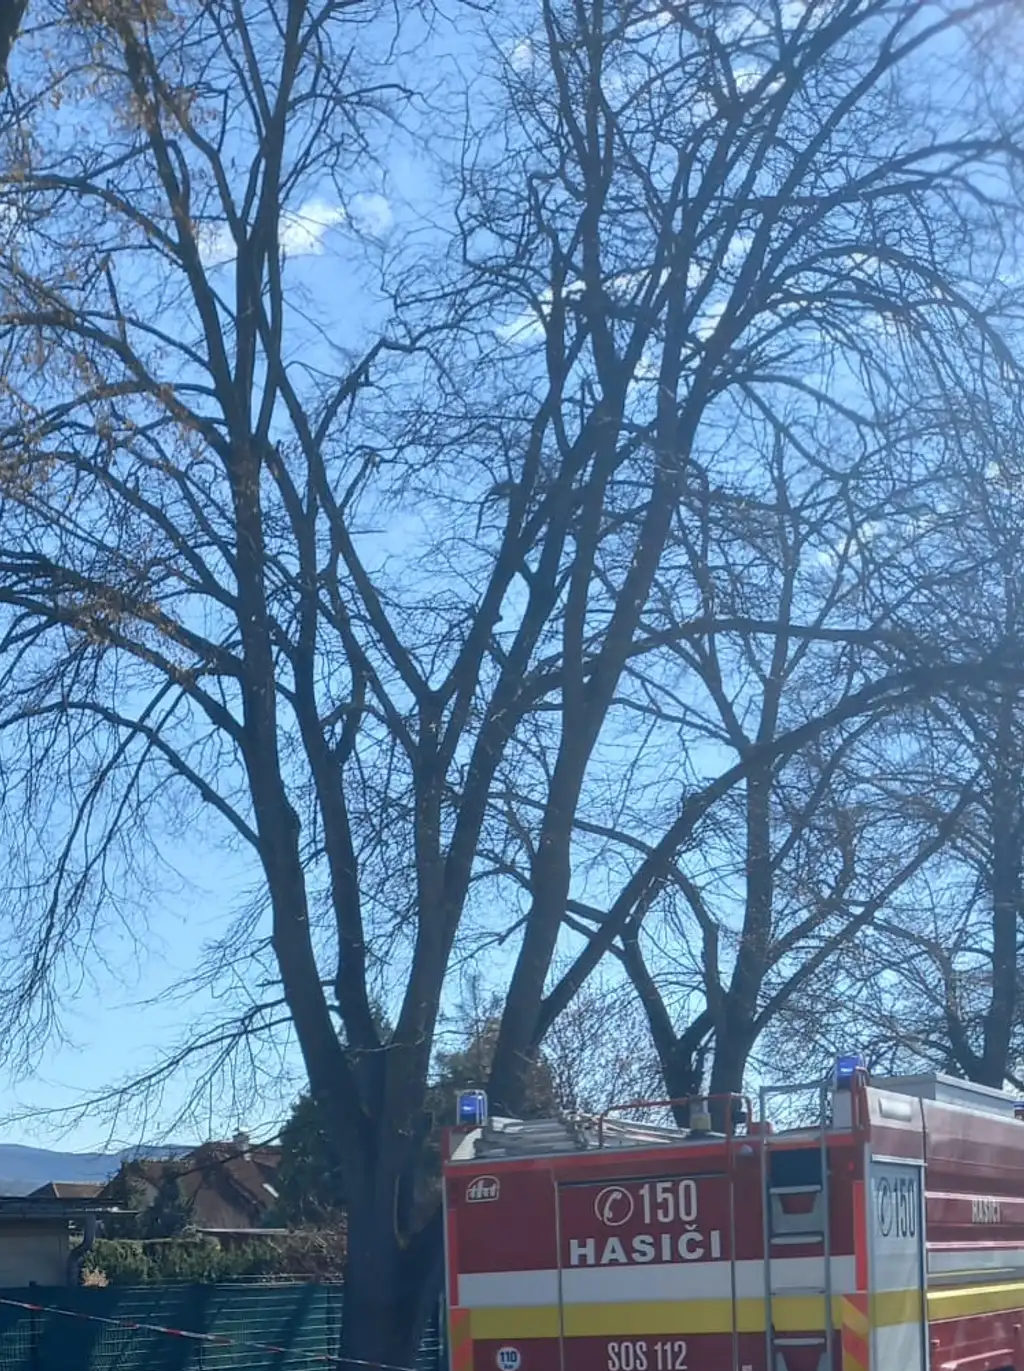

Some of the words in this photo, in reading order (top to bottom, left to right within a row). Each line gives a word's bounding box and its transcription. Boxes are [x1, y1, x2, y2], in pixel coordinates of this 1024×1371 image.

[639, 1179, 698, 1225] 150
[893, 1177, 917, 1238] 150
[569, 1224, 721, 1266] HASIČI
[500, 1351, 518, 1363] 110
[607, 1341, 648, 1371] SOS
[654, 1340, 688, 1371] 112
